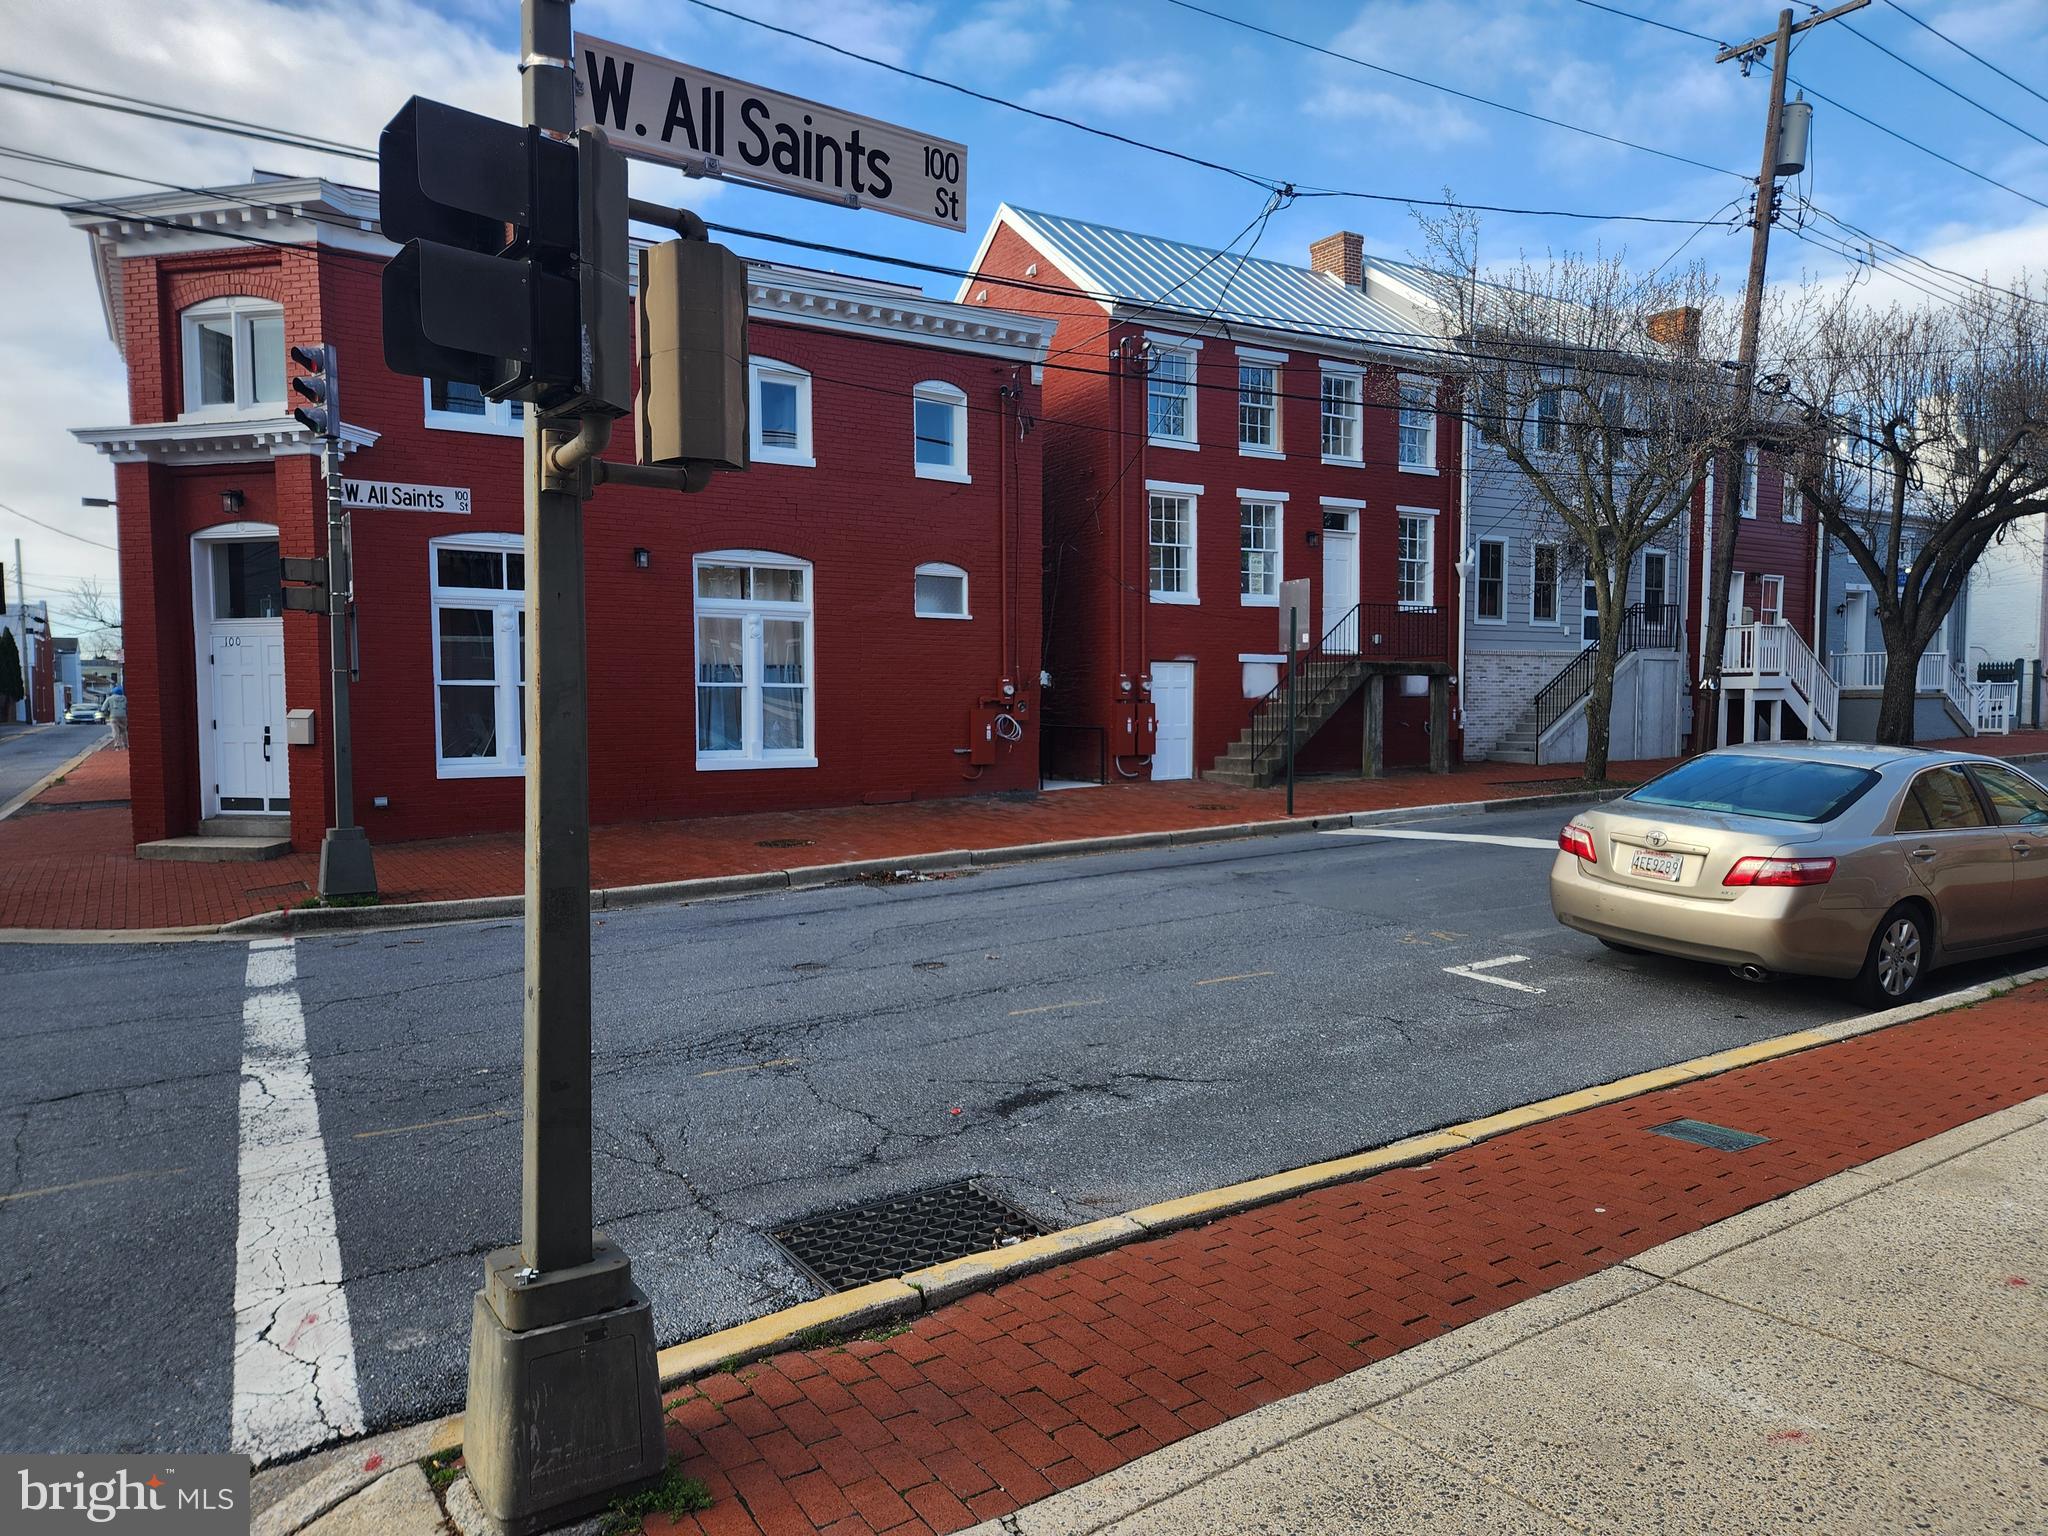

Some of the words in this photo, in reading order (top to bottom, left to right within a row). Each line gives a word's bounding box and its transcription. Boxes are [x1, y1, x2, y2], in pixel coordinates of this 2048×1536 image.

[584, 49, 647, 137] W.
[660, 76, 725, 157] All
[738, 98, 893, 200] Saints
[923, 145, 960, 184] 100
[934, 186, 960, 222] St
[344, 483, 363, 503] W.
[367, 485, 388, 505] All
[391, 486, 445, 509] Saints
[454, 490, 469, 501] 100
[459, 501, 469, 512] St
[225, 636, 241, 647] 100
[1632, 856, 1679, 874] 4EE9289
